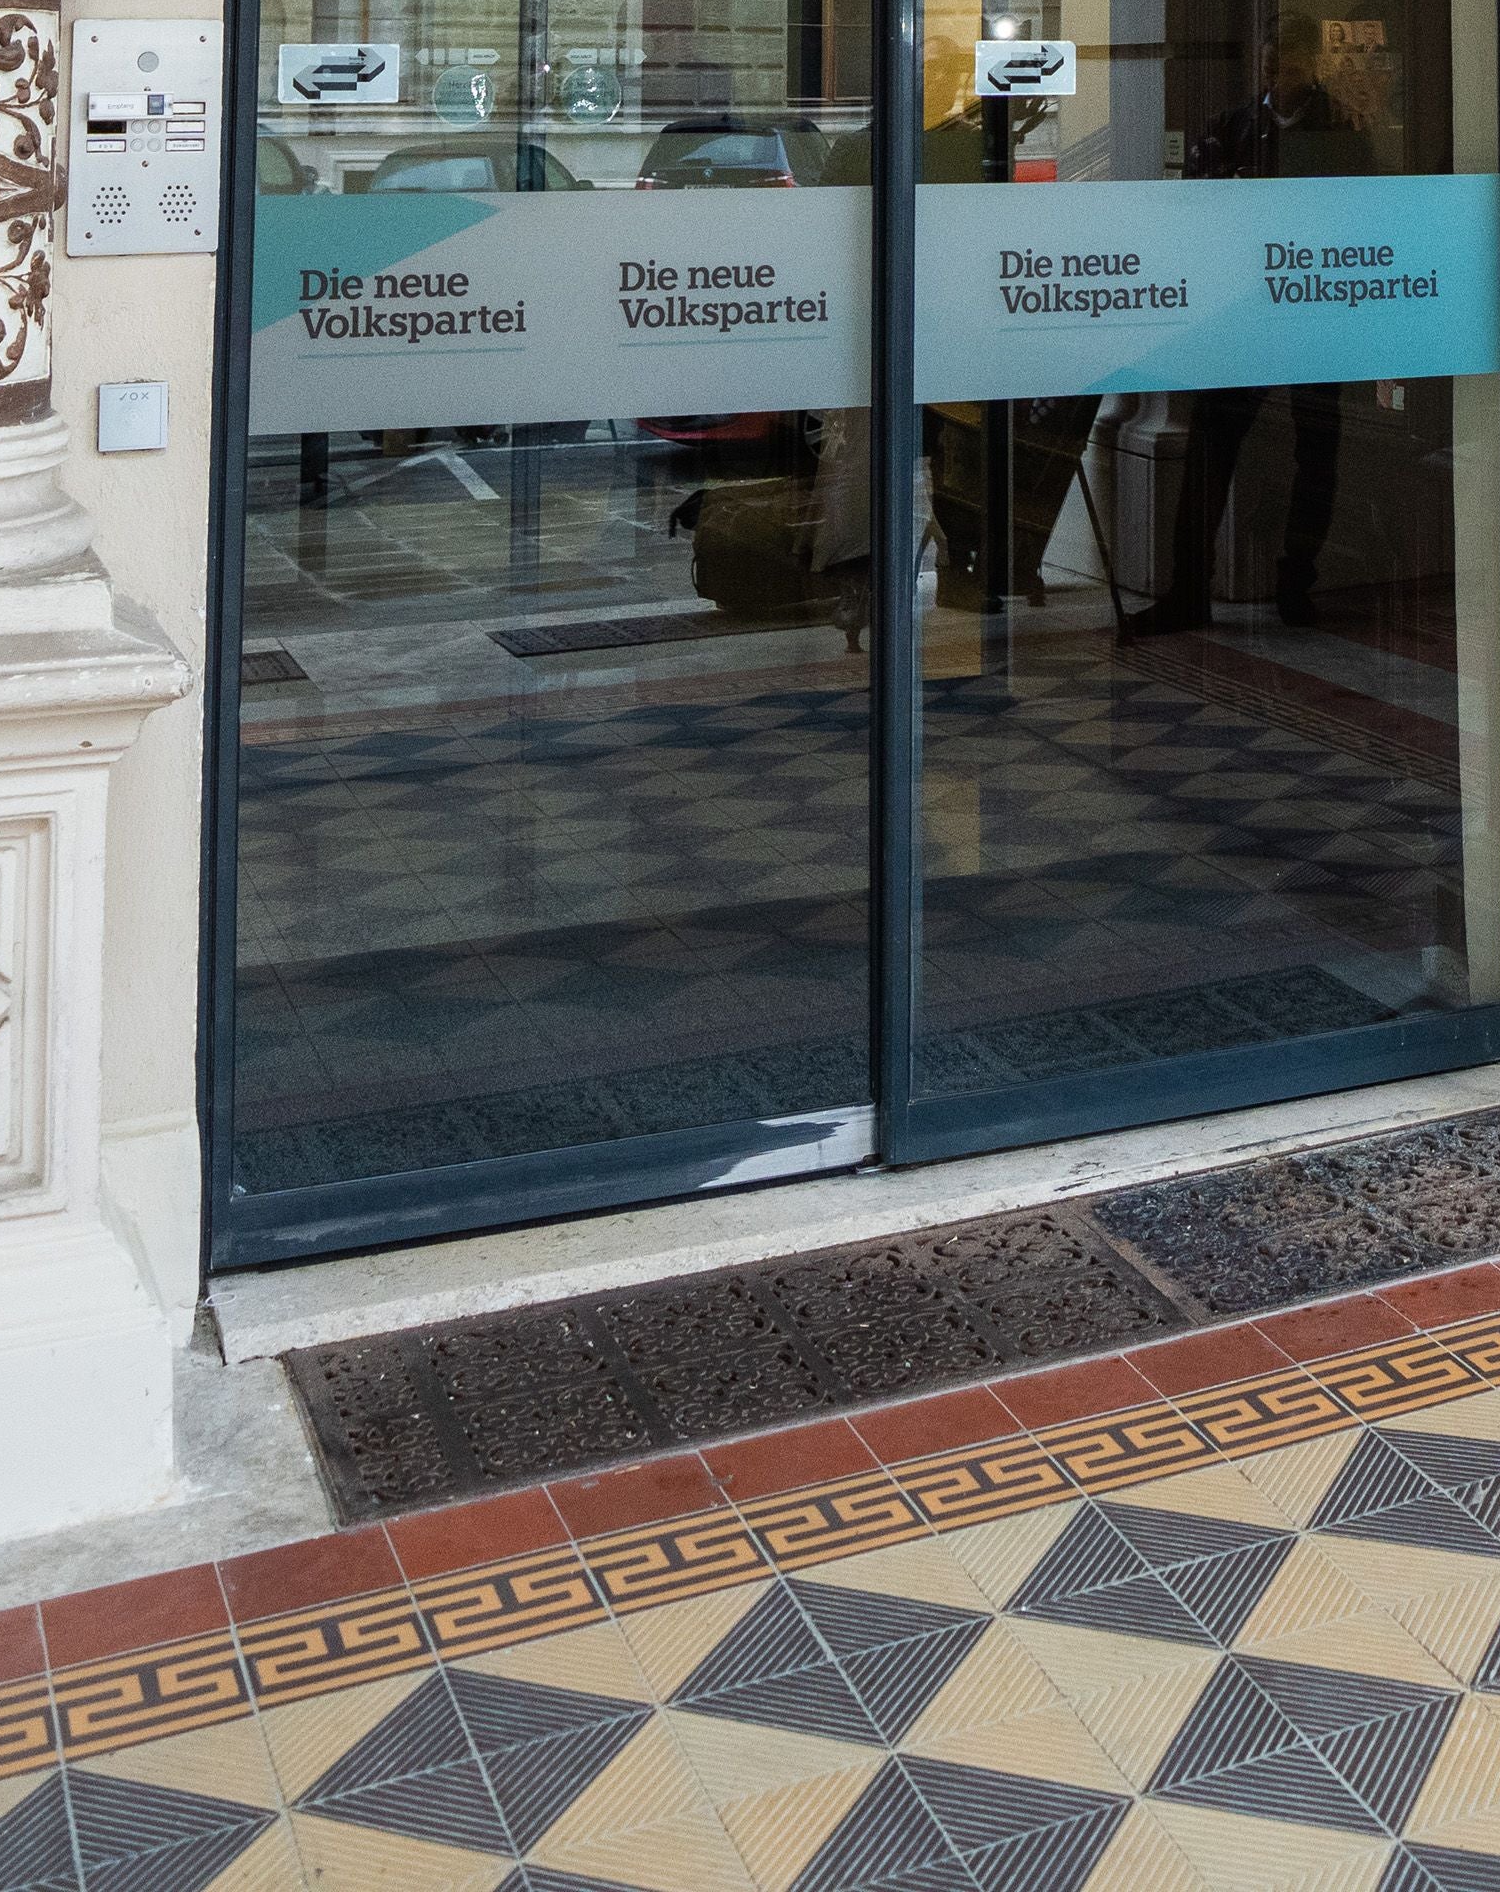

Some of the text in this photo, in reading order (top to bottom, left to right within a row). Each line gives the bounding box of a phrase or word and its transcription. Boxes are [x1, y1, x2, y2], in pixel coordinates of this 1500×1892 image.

[1000, 250, 1140, 279] Die neue
[1264, 242, 1394, 271] Die neue
[300, 270, 469, 299] Die neue
[619, 261, 775, 292] Die neue
[1264, 270, 1438, 308] Volkspartei
[619, 292, 828, 333] Volkspartei
[1000, 279, 1188, 317] Volkspartei
[300, 300, 526, 343] Volkspartei
